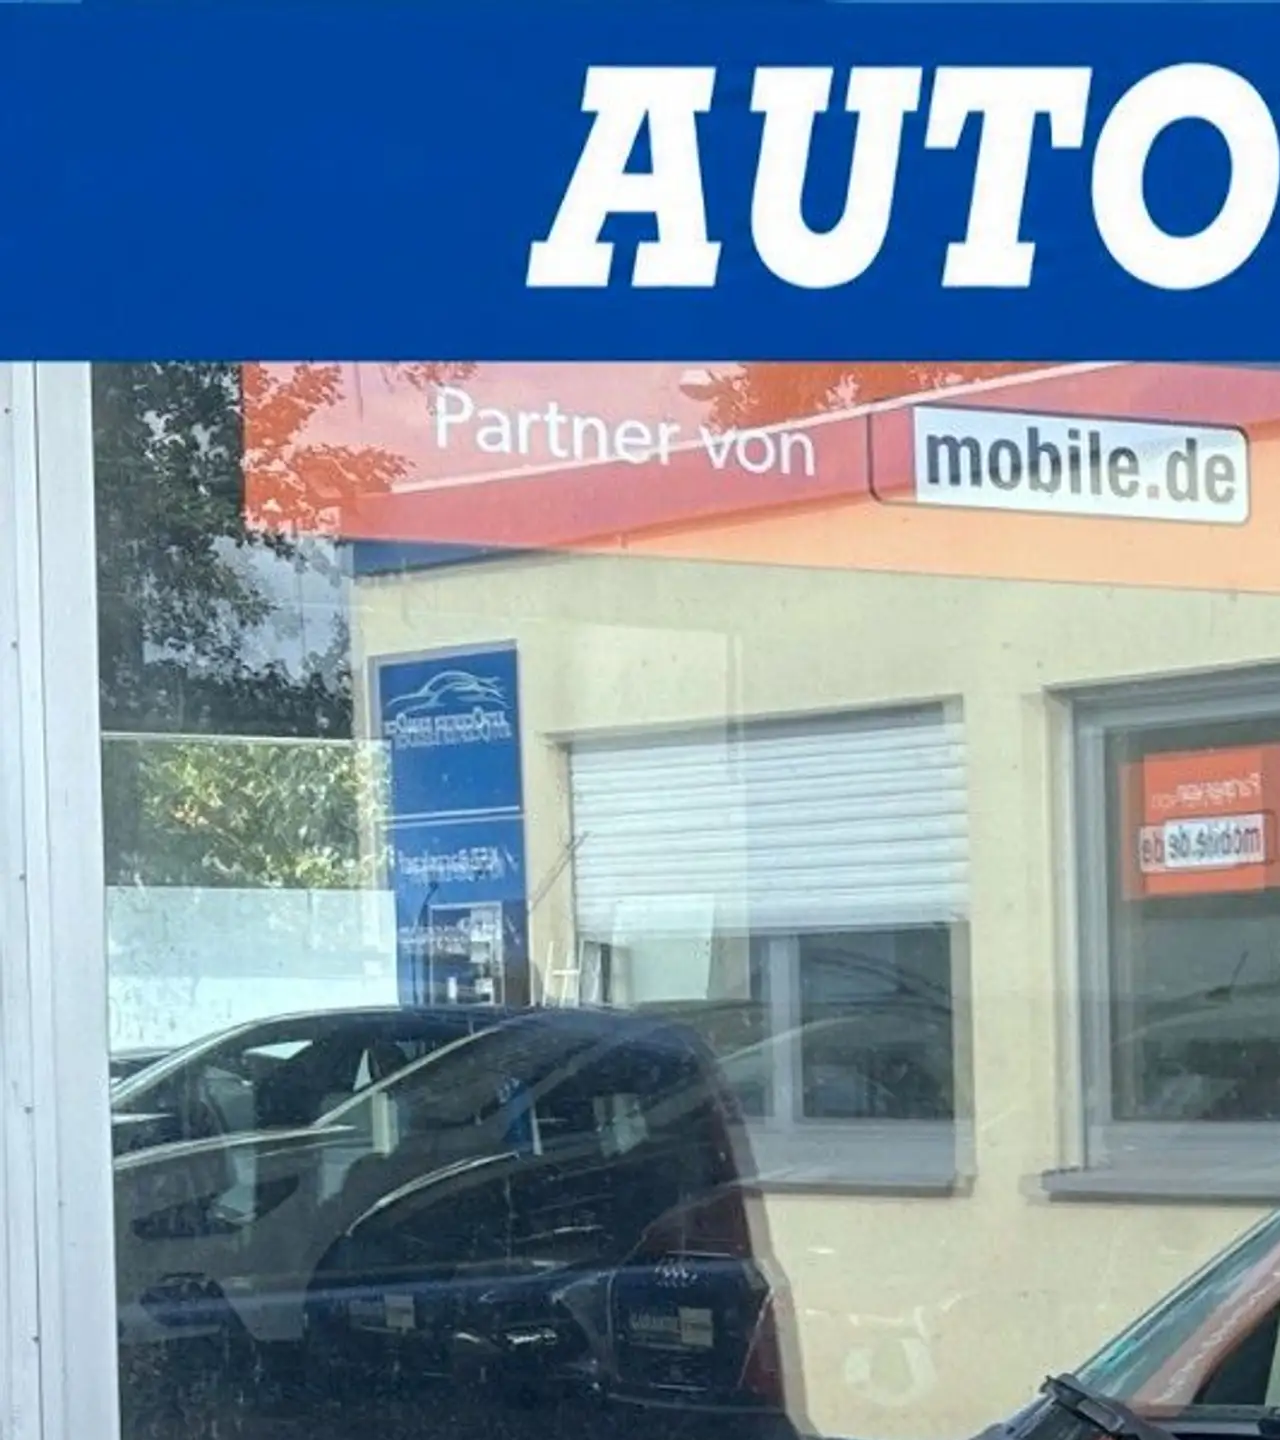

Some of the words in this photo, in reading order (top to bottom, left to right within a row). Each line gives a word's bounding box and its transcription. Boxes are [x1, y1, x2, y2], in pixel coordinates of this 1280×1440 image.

[434, 386, 679, 466] Partner
[704, 424, 815, 477] von
[926, 420, 1237, 506] mobile.de
